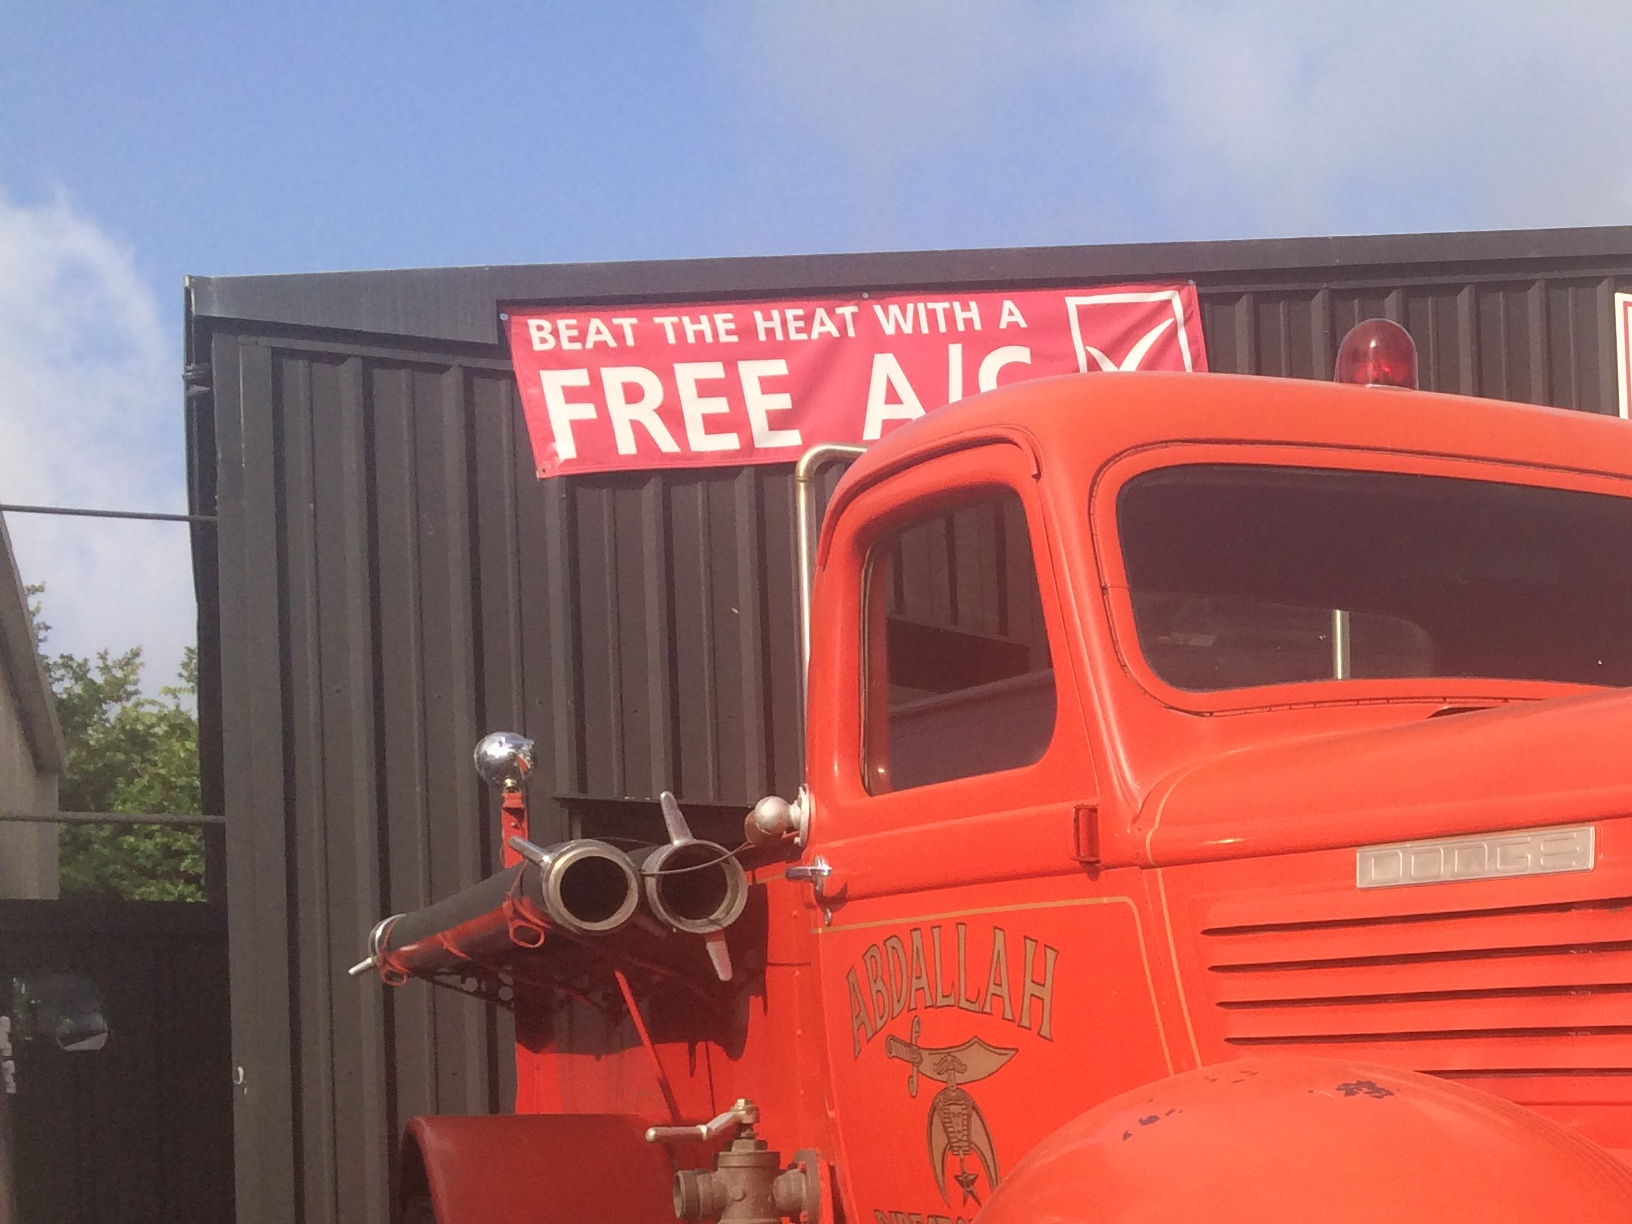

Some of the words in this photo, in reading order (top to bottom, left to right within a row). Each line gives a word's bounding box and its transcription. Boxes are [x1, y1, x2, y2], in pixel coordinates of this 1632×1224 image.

[528, 316, 639, 351] BEAT
[653, 313, 739, 343] THE
[753, 305, 859, 341] HEAT
[873, 301, 982, 336] WITH
[999, 299, 1028, 329] A
[538, 358, 803, 460] FREE
[1369, 831, 1580, 884] DODGE
[846, 922, 1059, 1061] ABDALLAH
